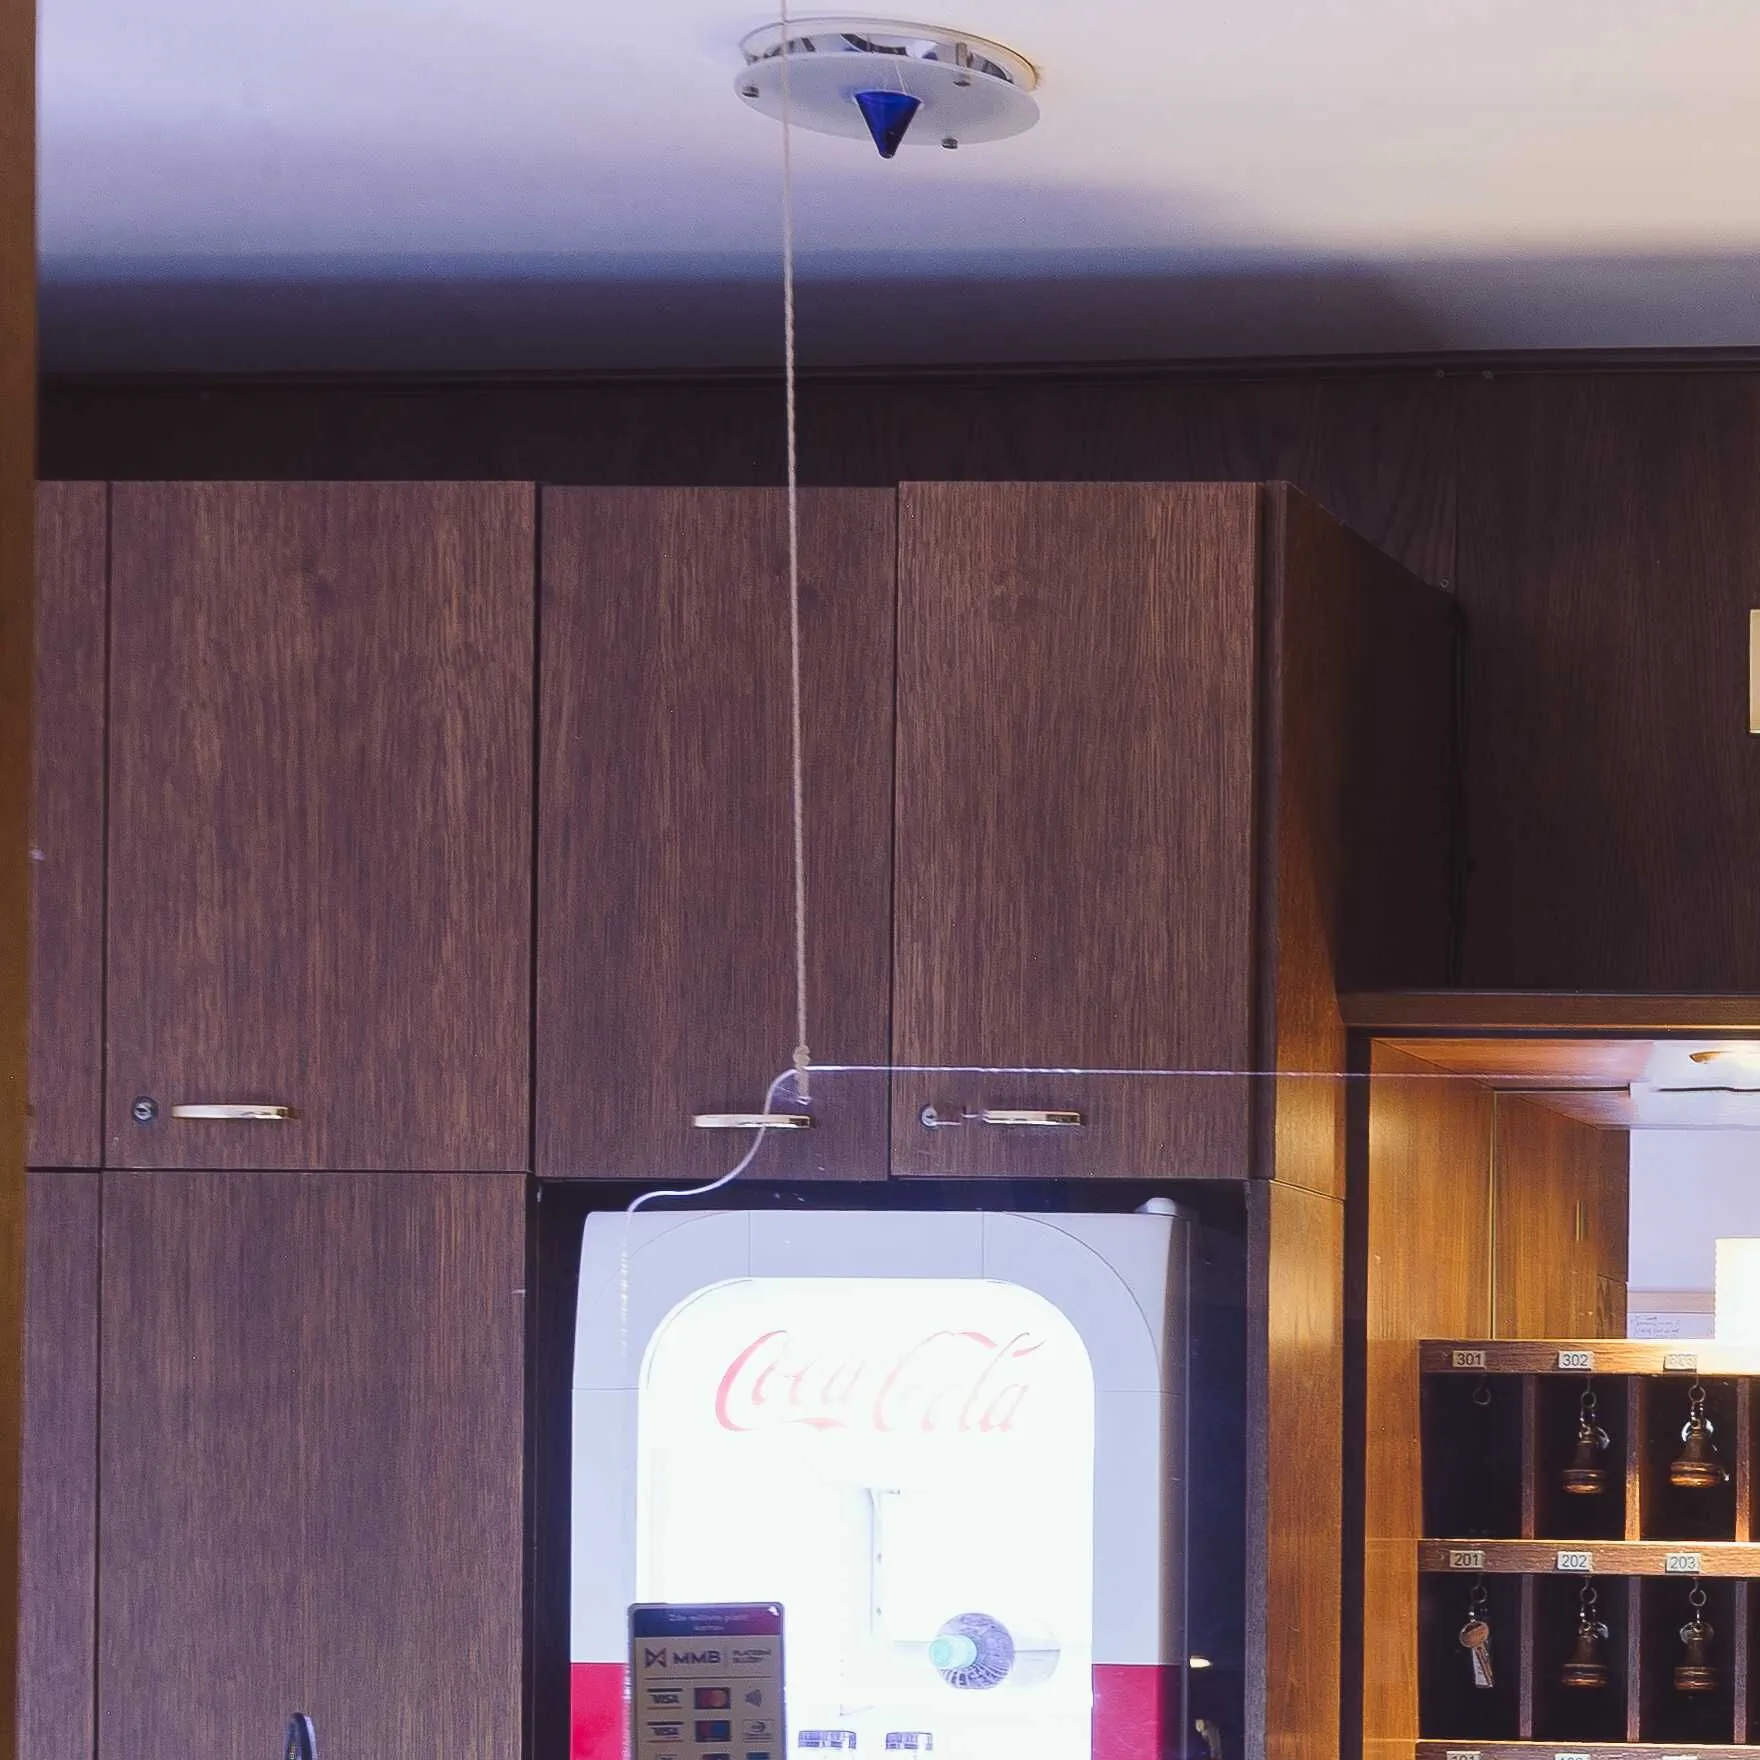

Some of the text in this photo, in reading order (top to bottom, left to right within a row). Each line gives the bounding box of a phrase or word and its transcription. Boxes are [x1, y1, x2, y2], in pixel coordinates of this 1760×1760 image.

[1455, 1353, 1482, 1366] 301
[1562, 1354, 1589, 1366] 302
[1453, 1553, 1480, 1567] 201
[1561, 1555, 1588, 1568] 202
[1670, 1556, 1696, 1569] 203
